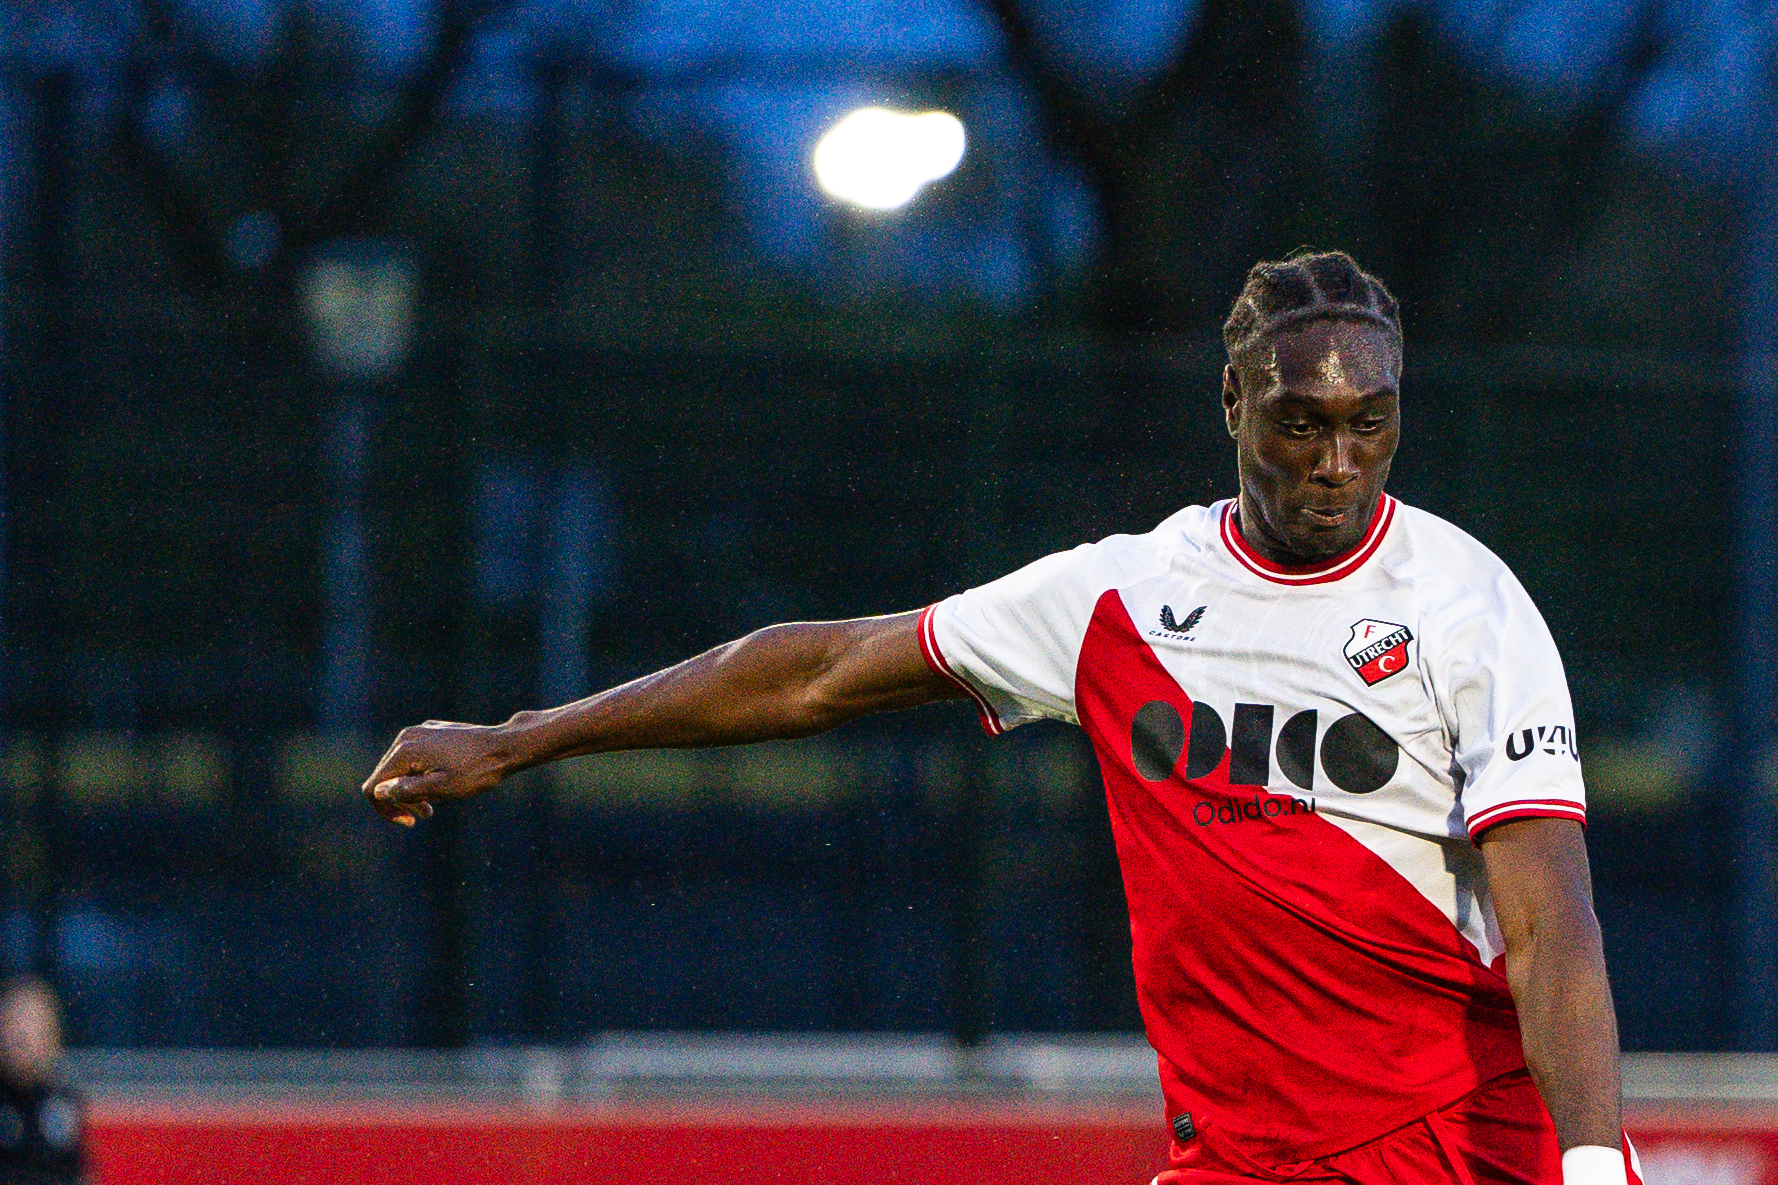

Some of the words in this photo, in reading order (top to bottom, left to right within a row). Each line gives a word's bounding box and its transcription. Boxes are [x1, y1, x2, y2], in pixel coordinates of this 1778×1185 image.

[1364, 624, 1376, 639] F
[1349, 628, 1409, 668] UTRECHT
[1378, 655, 1396, 673] C
[1193, 794, 1316, 827] Odido.nl
